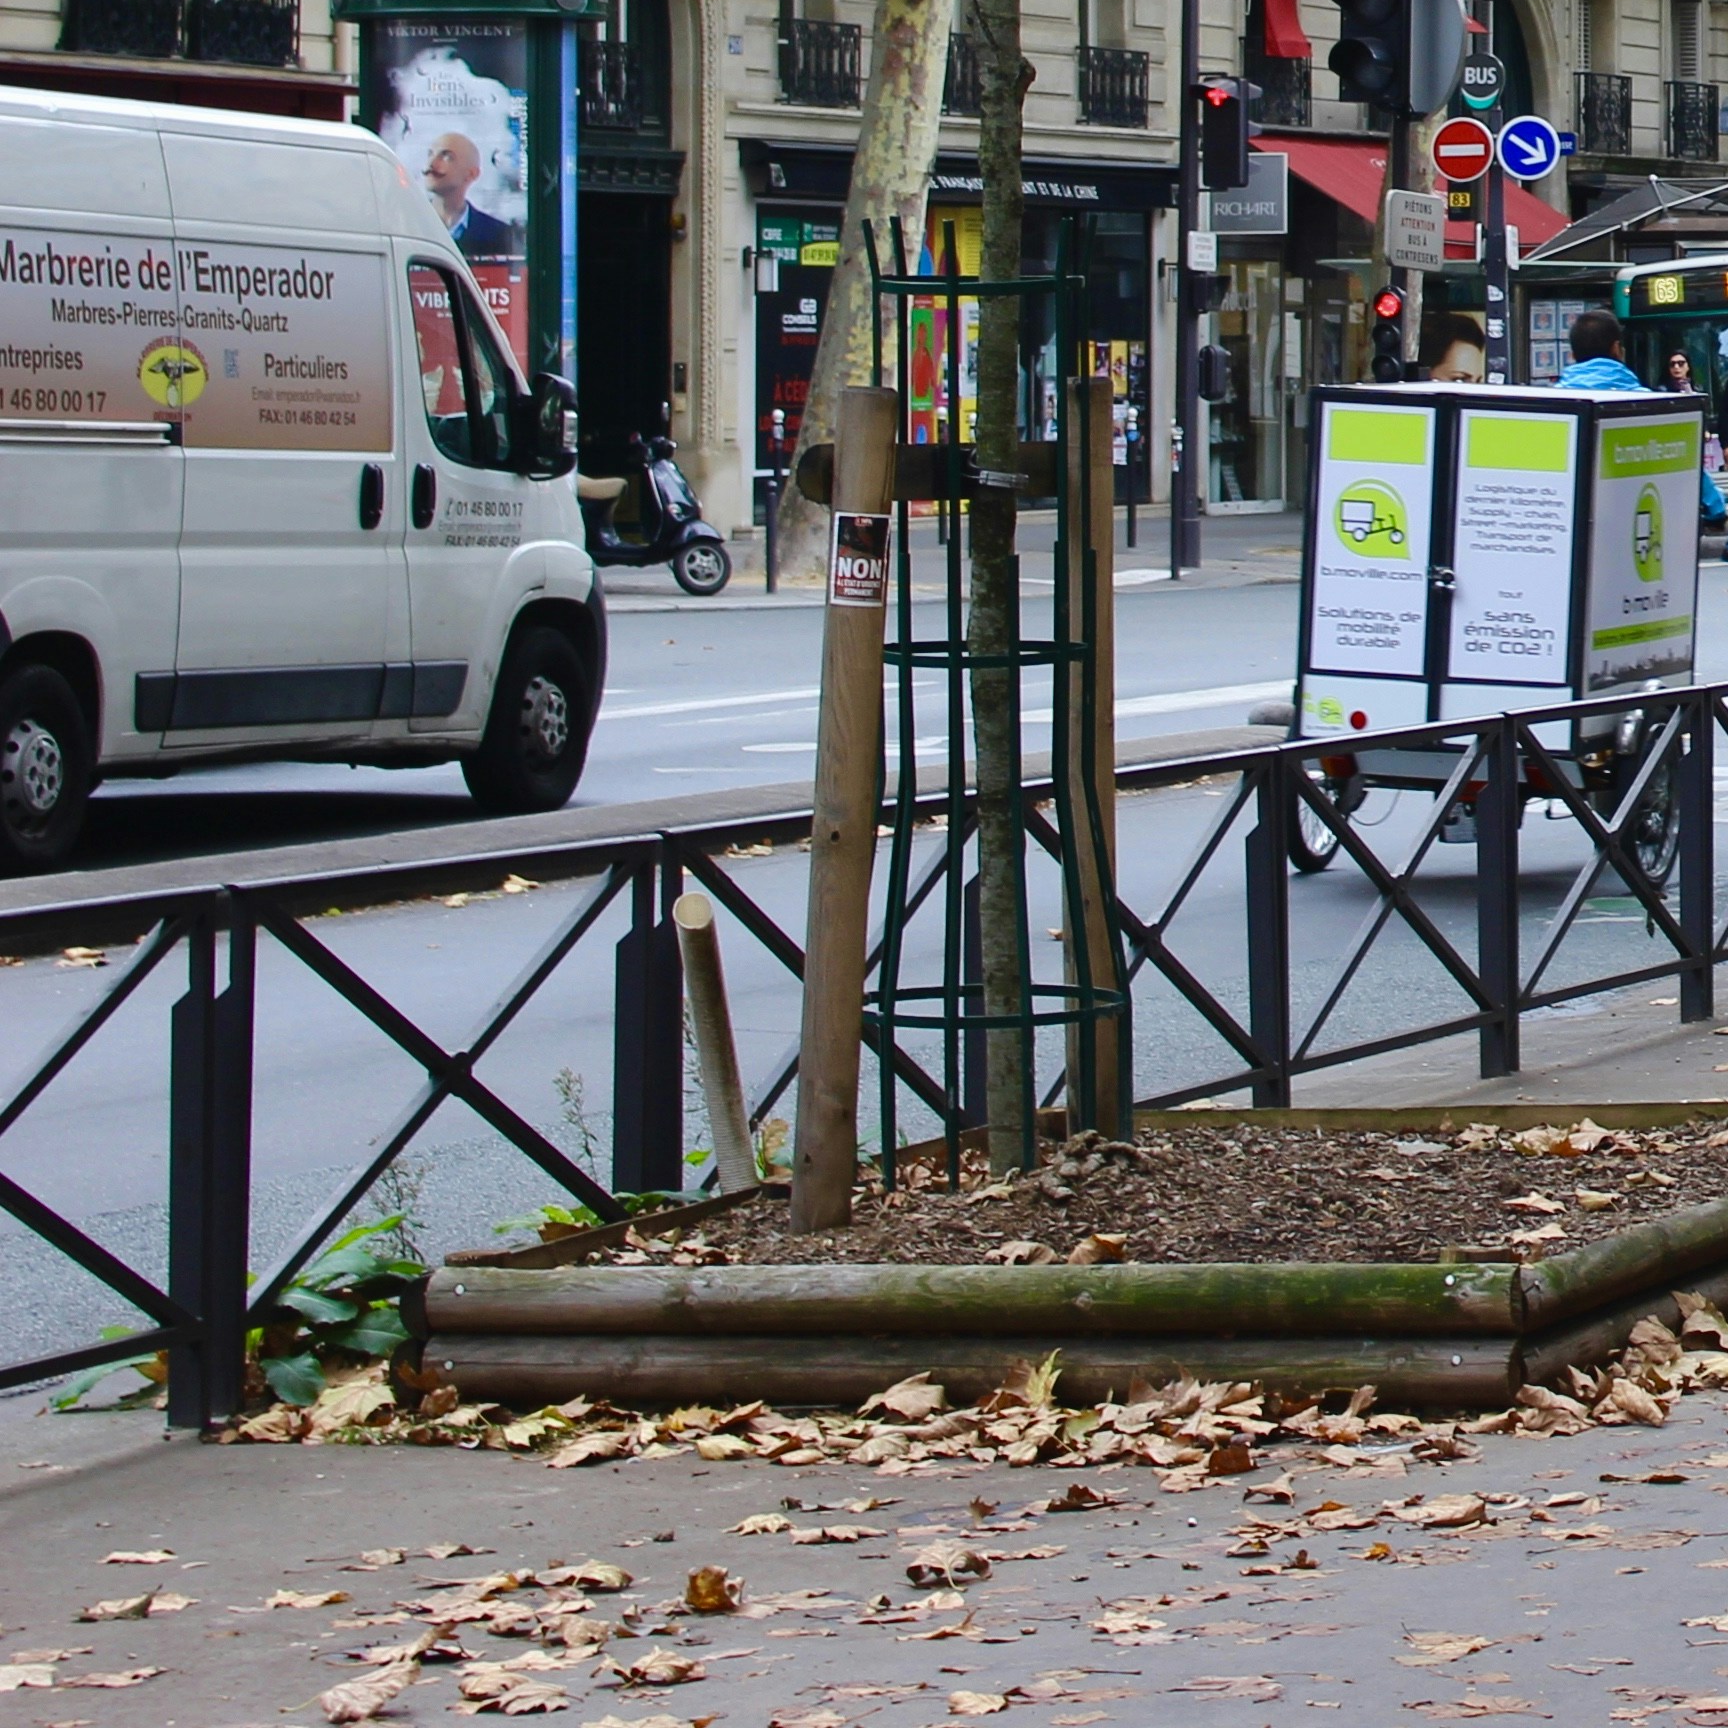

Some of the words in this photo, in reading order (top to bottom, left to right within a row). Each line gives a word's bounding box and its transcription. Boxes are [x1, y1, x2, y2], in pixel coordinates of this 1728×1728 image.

[387, 26, 438, 38] VIKTOR
[444, 26, 513, 37] VINCENT
[1464, 67, 1497, 84] BUS
[410, 93, 486, 109] Invisibles
[937, 176, 983, 192] FRANÇAIS
[1452, 193, 1469, 206] 83
[1401, 217, 1435, 232] ATTENTION
[0, 239, 130, 289] Marbrerie
[138, 249, 171, 291] de
[178, 251, 335, 305] l’Emperador
[1654, 278, 1678, 303] 63
[264, 353, 349, 380] Particuliers
[10, 388, 32, 410] 46
[36, 389, 57, 411] 80
[61, 390, 82, 412] 00
[87, 391, 106, 412] 17
[457, 501, 468, 515] 01
[485, 502, 497, 516] 80
[499, 503, 511, 516] 00
[512, 503, 523, 516] 17
[838, 557, 882, 579] NON
[1498, 590, 1523, 599] tout
[1317, 606, 1395, 621] Solutions
[1399, 612, 1422, 623] de
[1484, 611, 1535, 623] sans
[1336, 622, 1401, 635] mobilité
[1464, 621, 1555, 640] émission
[1336, 634, 1401, 648] durable
[1465, 639, 1492, 653] de
[1498, 641, 1541, 656] CO2
